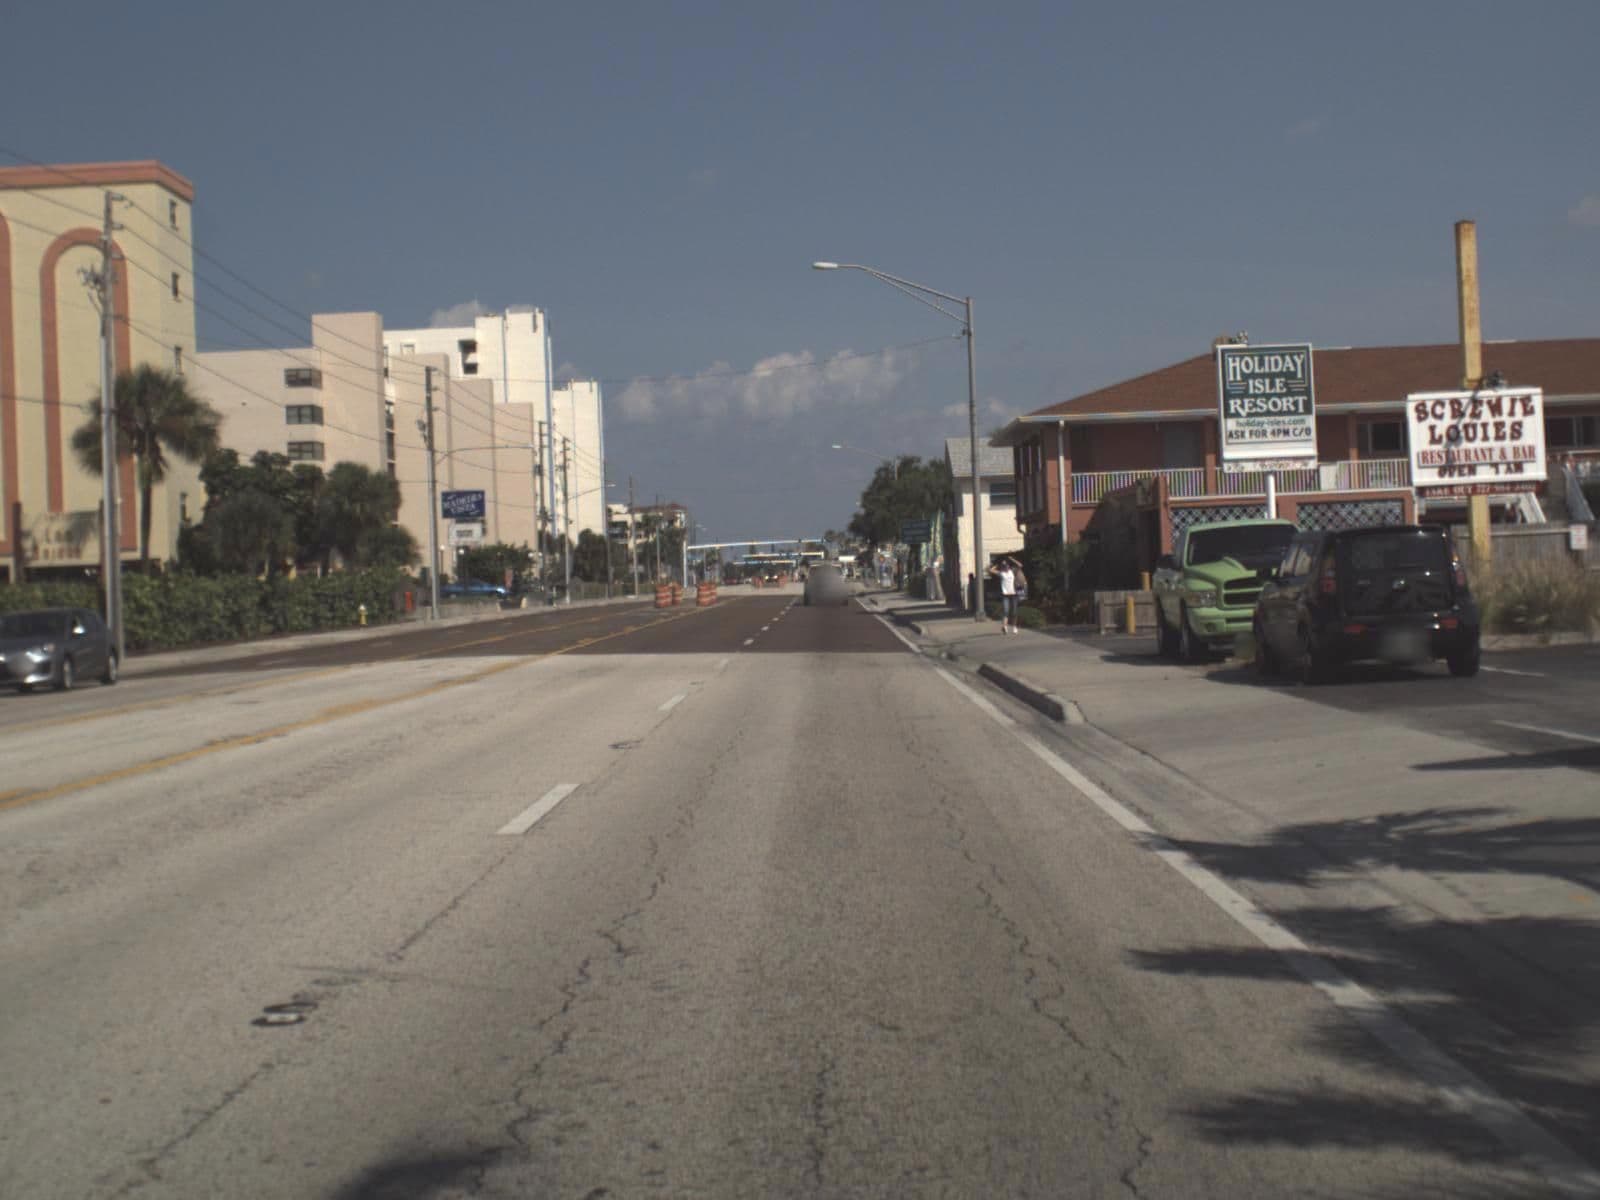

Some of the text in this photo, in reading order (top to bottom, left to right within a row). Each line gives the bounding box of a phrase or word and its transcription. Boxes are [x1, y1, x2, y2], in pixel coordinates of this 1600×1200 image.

[1227, 354, 1305, 381] HOLIDAY
[1248, 378, 1287, 394] ISLE
[1228, 396, 1307, 417] RESORT
[1414, 395, 1535, 422] SCREWIE
[1228, 429, 1246, 440] ASK
[1249, 428, 1268, 439] FOR
[1270, 427, 1290, 438] 4PM
[1428, 421, 1523, 445] LOUIES
[1421, 447, 1493, 465] RESTAURANT
[1513, 445, 1536, 460] BAR
